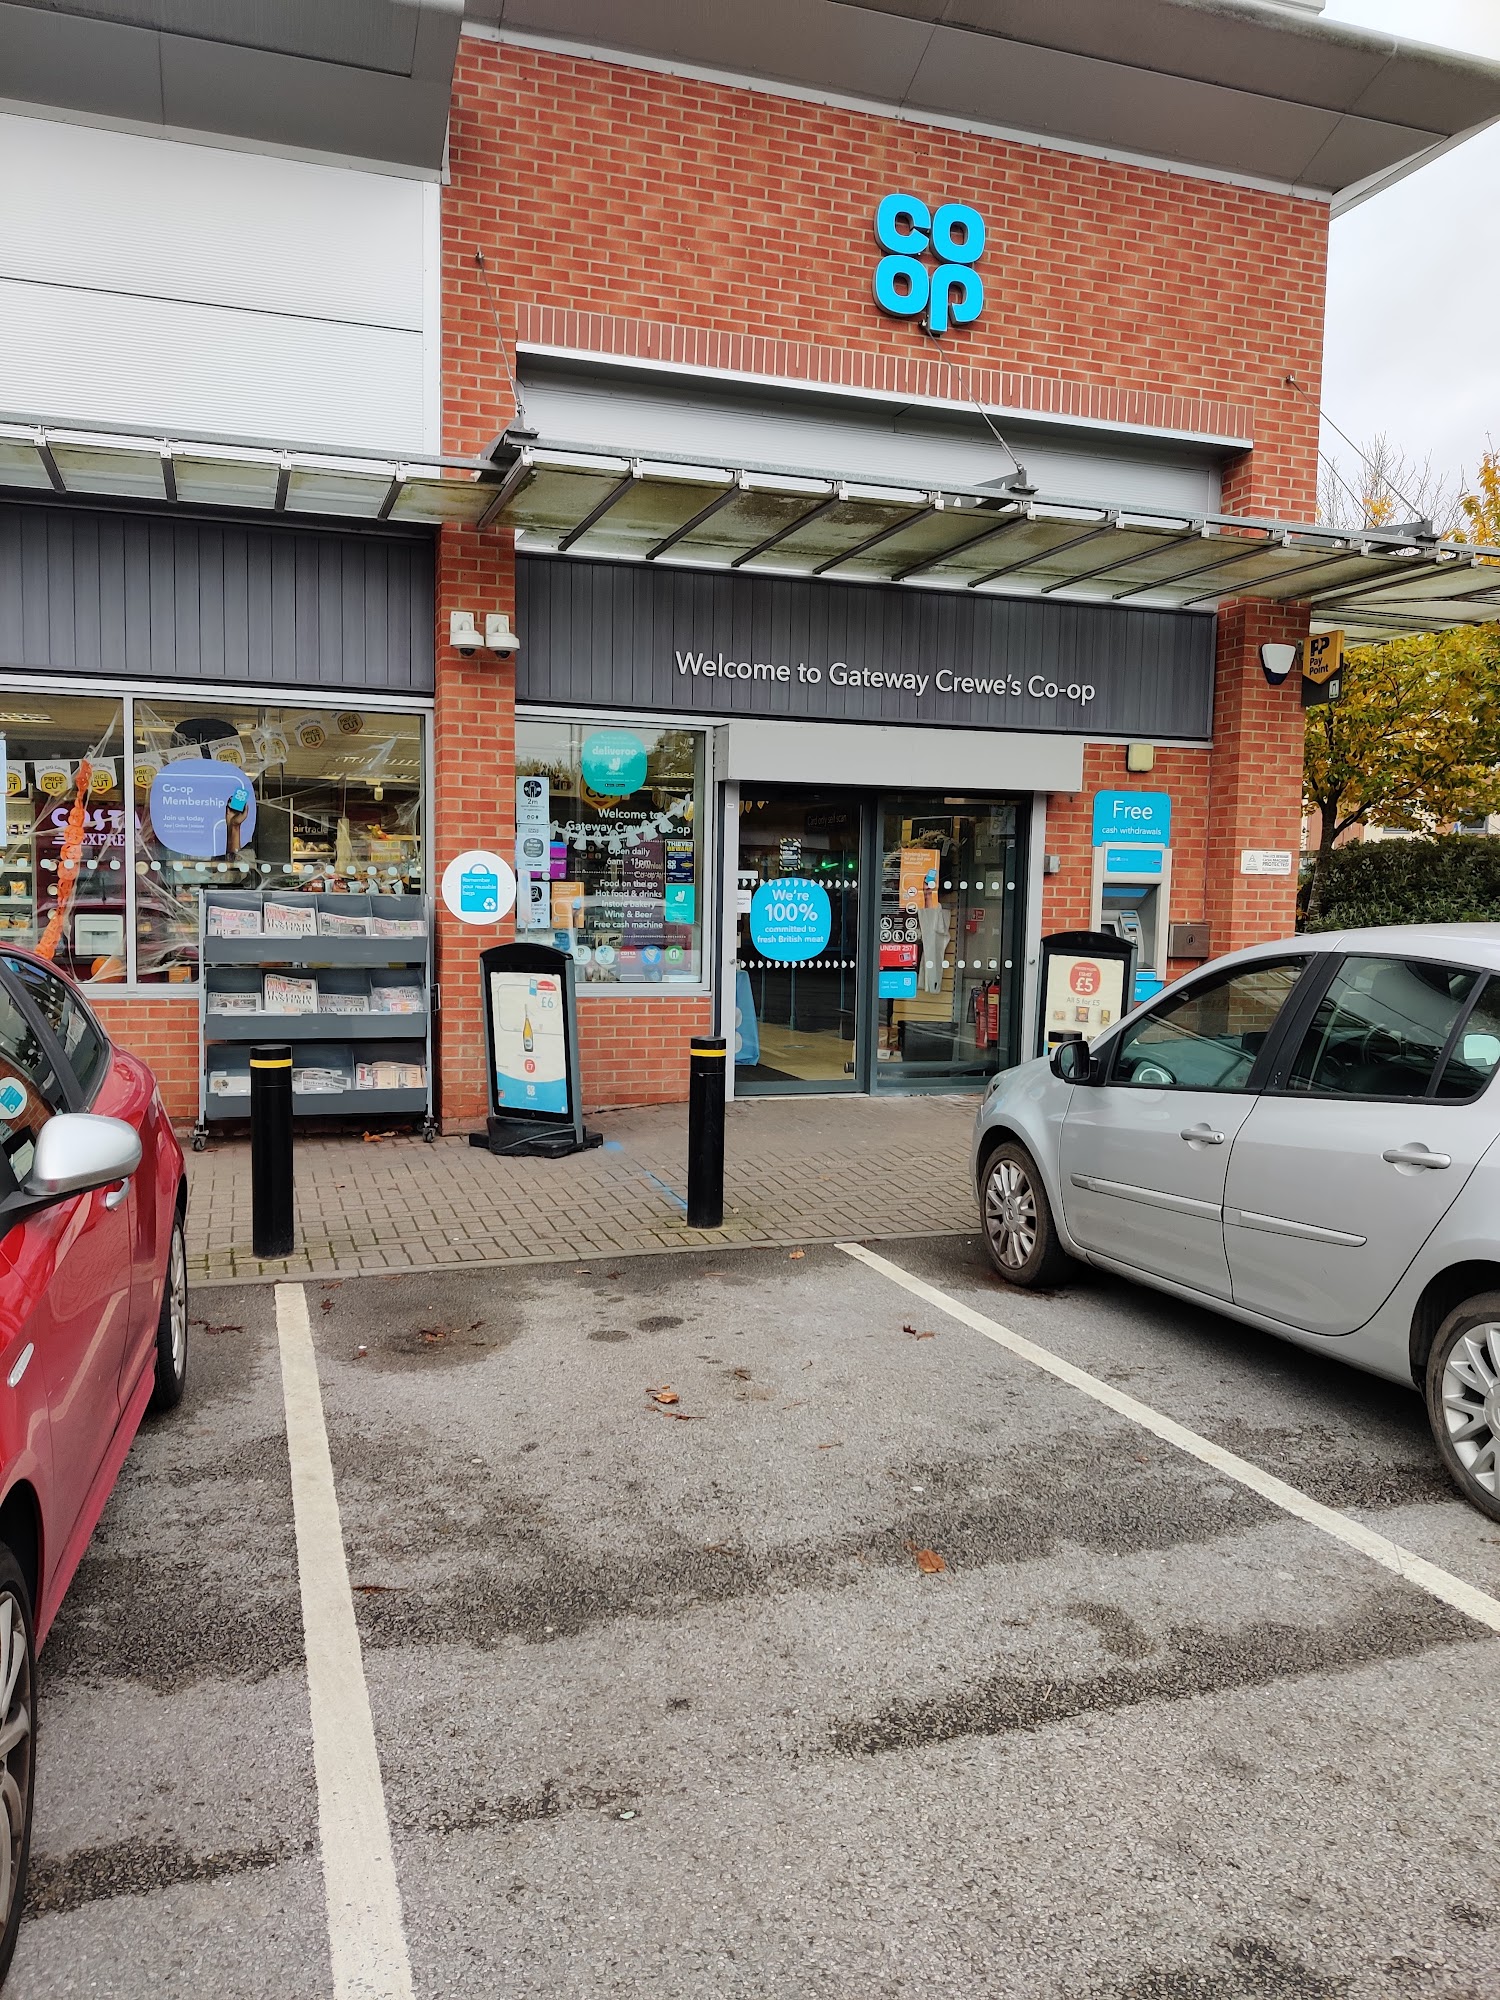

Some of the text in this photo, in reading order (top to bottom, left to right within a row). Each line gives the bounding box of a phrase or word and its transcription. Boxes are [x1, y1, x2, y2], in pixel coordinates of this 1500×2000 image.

[1310, 657, 1323, 667] Pay
[1310, 664, 1329, 675] Point
[675, 651, 1096, 706] Welcome to Gateway Crewe's Co-op
[342, 720, 360, 731] CUT
[305, 734, 322, 744] CUT
[592, 746, 637, 756] deliveroo
[45, 782, 63, 790] CUT
[162, 783, 193, 795] Co-op
[162, 796, 225, 807] Membership
[597, 808, 647, 819] Welcome
[1113, 800, 1153, 820] Free
[186, 815, 204, 823] today
[566, 821, 613, 835] Gateway
[1101, 826, 1161, 836] cash withdrawals
[608, 848, 650, 858] Open daily
[630, 858, 651, 866] 11pm
[639, 890, 662, 898] drinks
[772, 889, 810, 901] We're
[630, 900, 656, 910] bakery
[764, 903, 818, 922] 100%
[632, 921, 663, 929] machine
[764, 925, 806, 933] committed
[757, 935, 777, 943] fresh
[778, 935, 803, 943] British
[880, 944, 901, 952] UNDER
[1075, 977, 1094, 993] £5
[541, 996, 554, 1009] £6
[1081, 997, 1091, 1005] for
